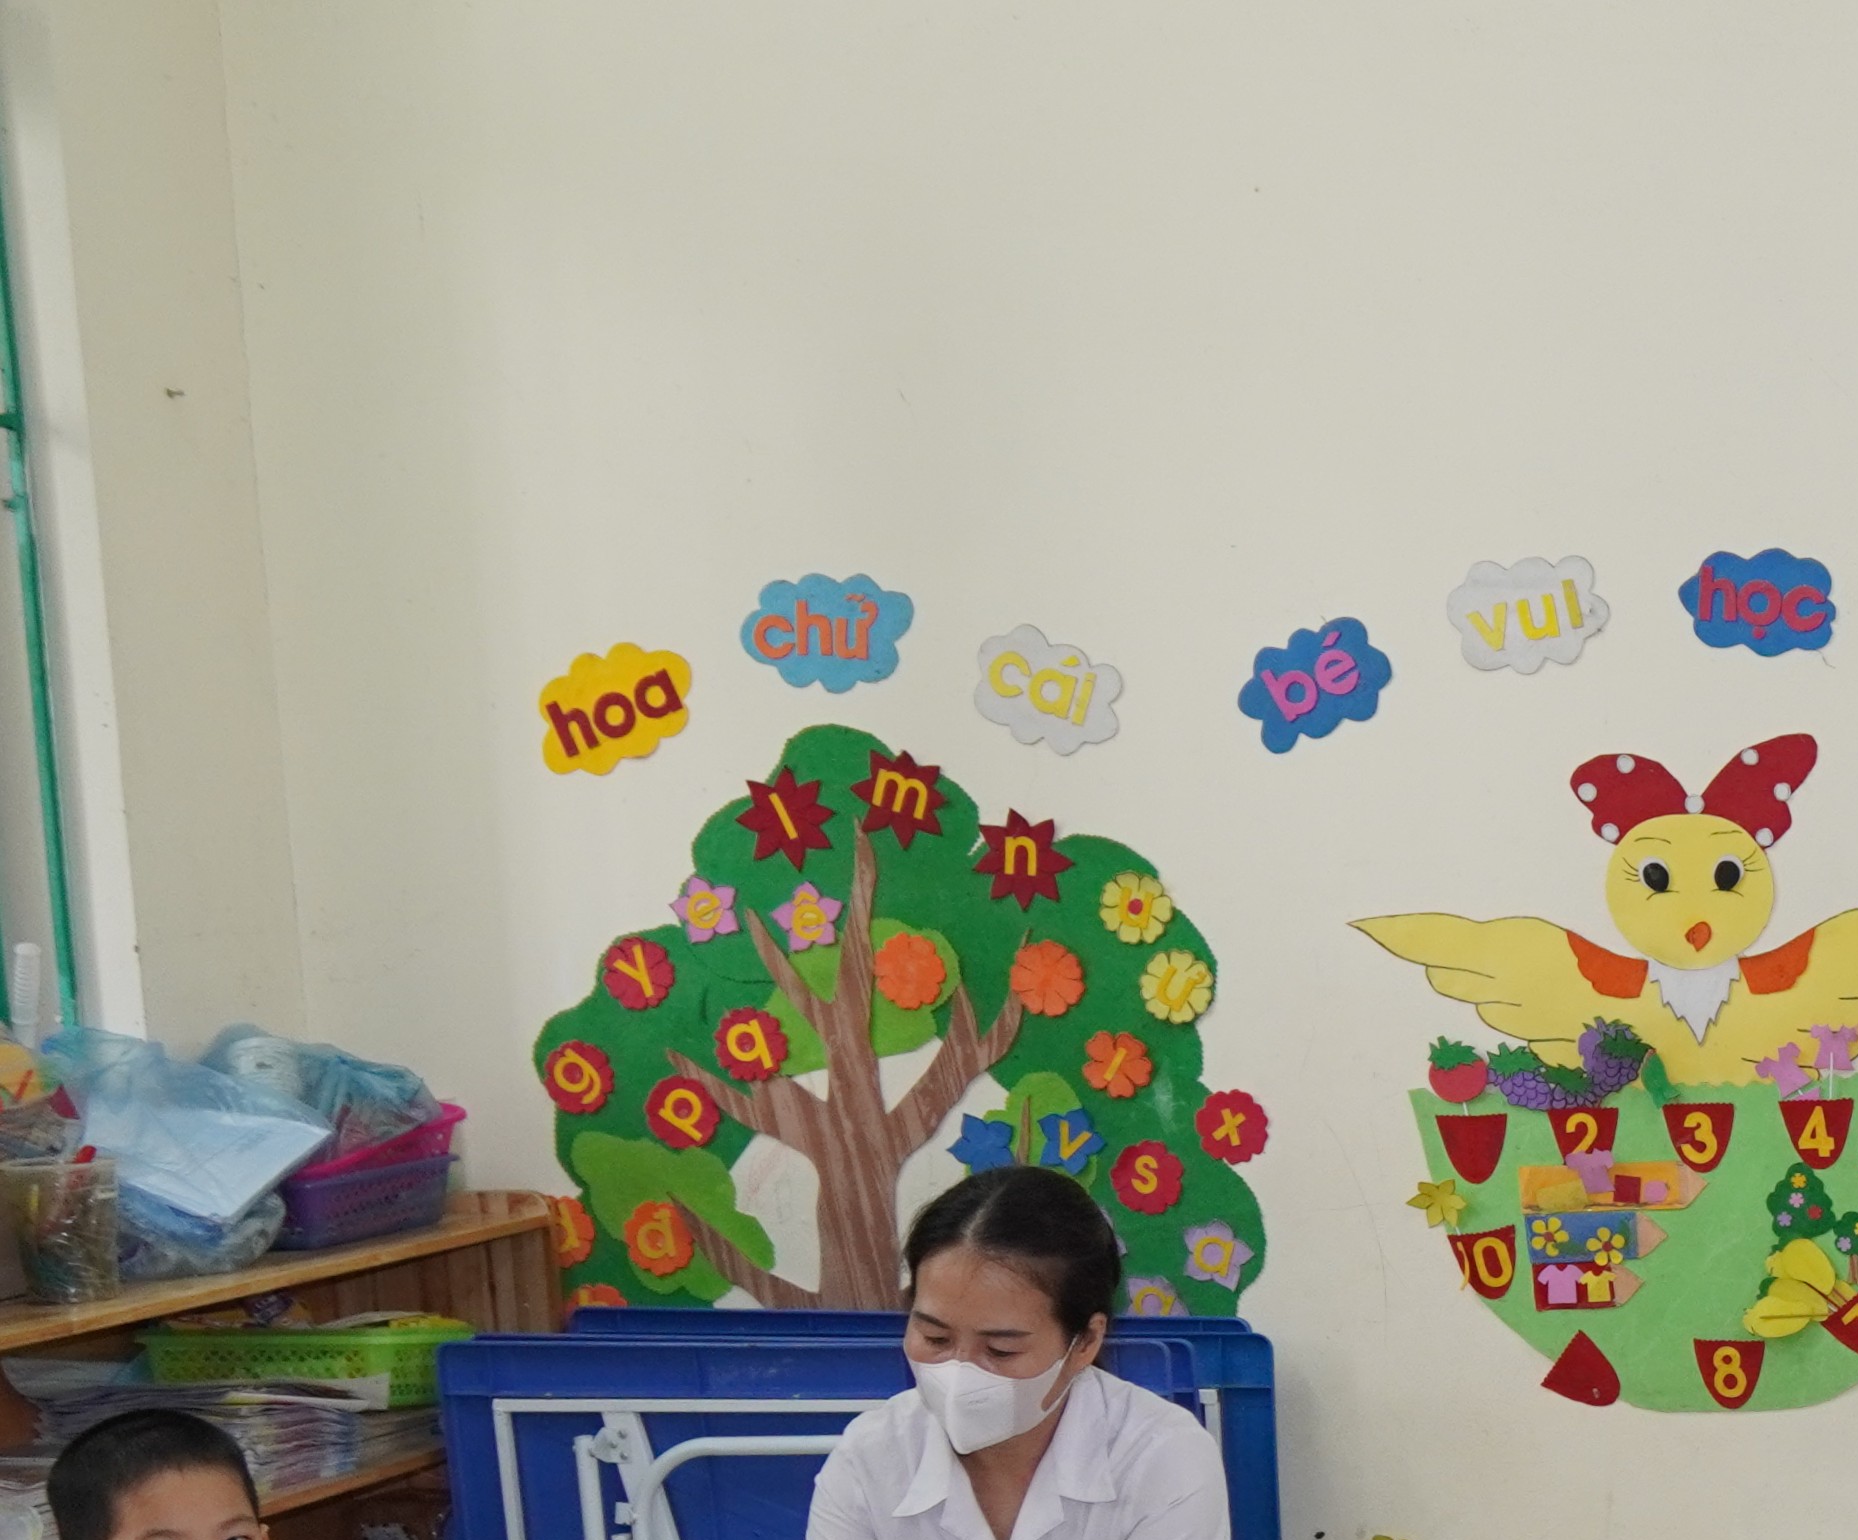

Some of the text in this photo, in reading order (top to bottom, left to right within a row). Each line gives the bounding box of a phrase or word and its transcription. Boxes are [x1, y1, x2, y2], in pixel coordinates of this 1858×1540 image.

[1260, 631, 1361, 722] bé
[1466, 578, 1585, 652] vui
[1698, 565, 1829, 640] học
[545, 594, 1097, 758] hoa chữ cái
[872, 768, 929, 819] m
[1004, 836, 1038, 877] n
[686, 891, 724, 929] e
[791, 891, 828, 941] ê
[726, 1018, 774, 1069] q
[553, 1048, 601, 1105] g
[658, 1088, 704, 1142] p
[1059, 1120, 1093, 1161] v
[1211, 1107, 1247, 1147] x
[1565, 1112, 1599, 1154] 2
[1680, 1111, 1718, 1164] 3
[1798, 1105, 1836, 1158] 4
[636, 1207, 677, 1260] đ
[1192, 1236, 1236, 1277] a
[1712, 1346, 1748, 1398] 8
